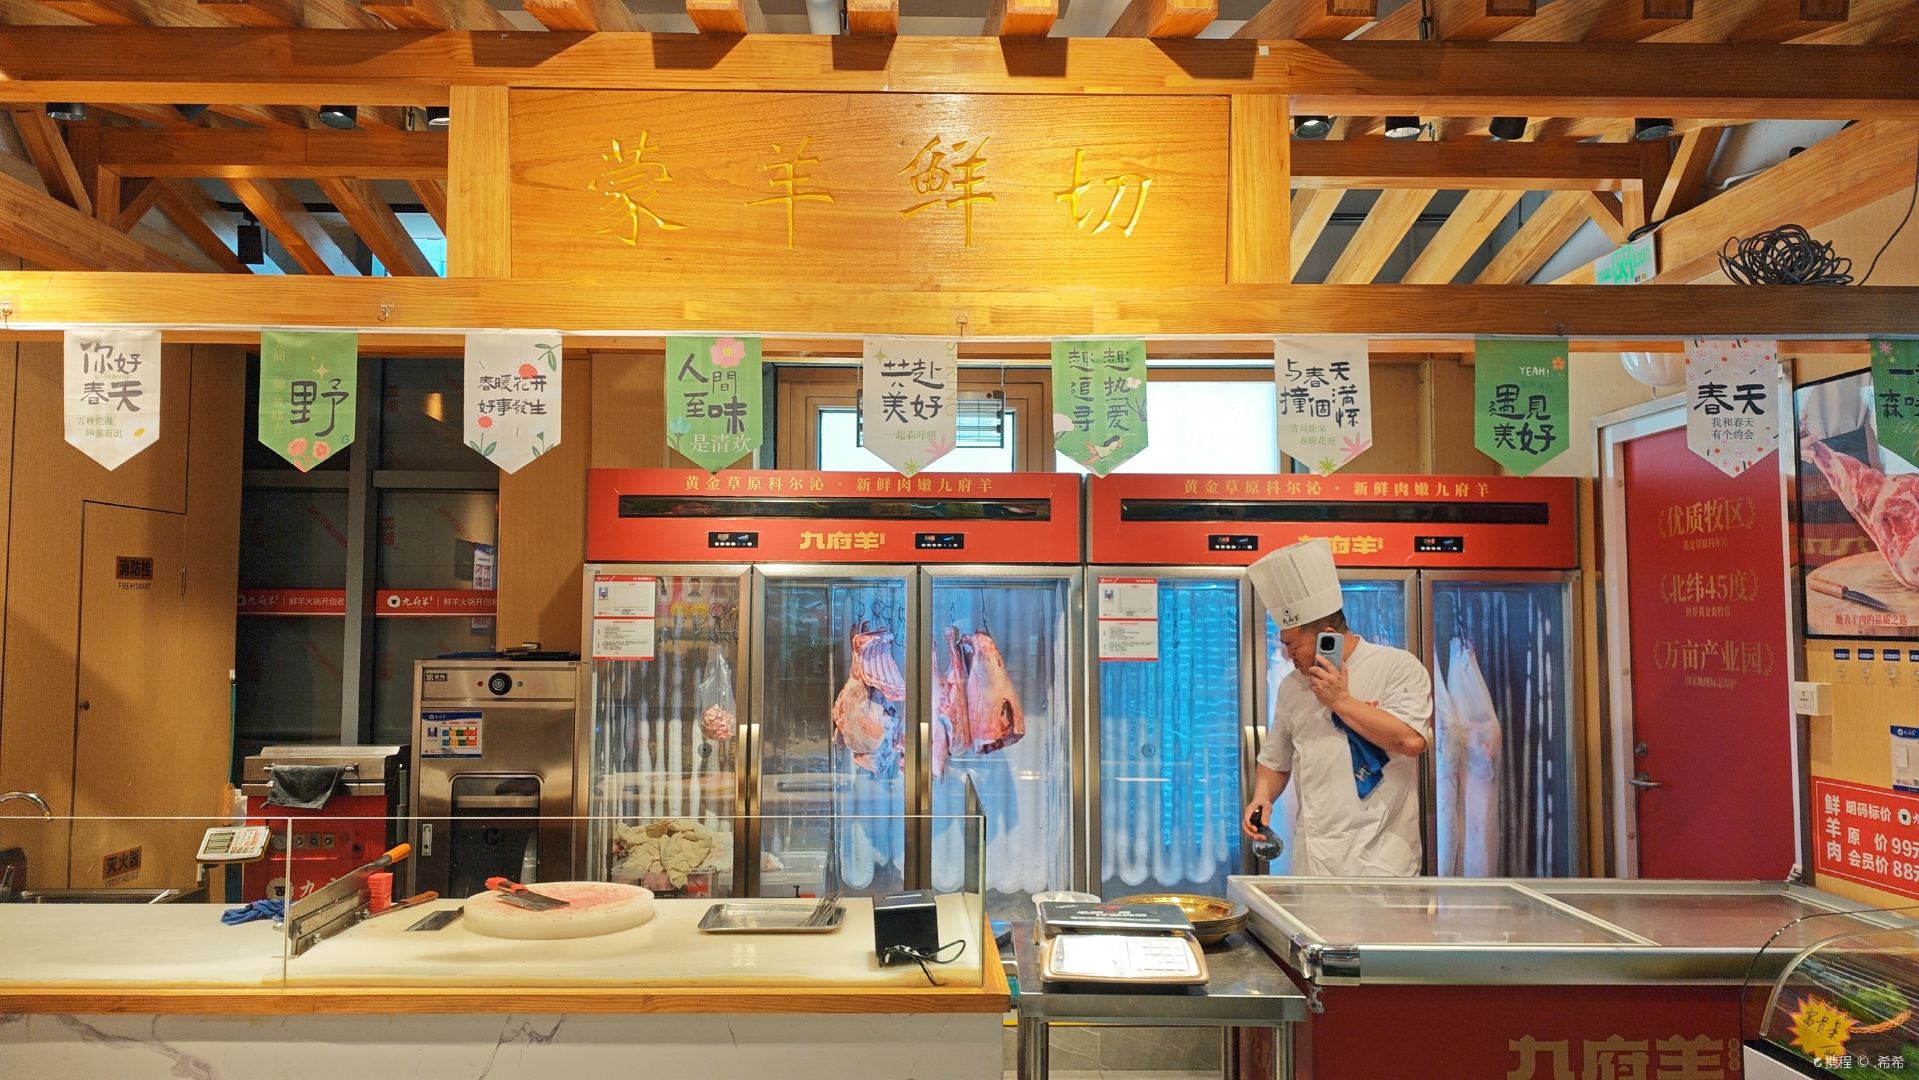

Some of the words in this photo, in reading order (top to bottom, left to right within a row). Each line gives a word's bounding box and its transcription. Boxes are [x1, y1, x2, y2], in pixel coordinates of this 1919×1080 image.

[588, 130, 1152, 249] 蒙羊鲜切
[80, 341, 142, 374] 你好
[1520, 366, 1550, 377] YEAH!
[477, 374, 547, 392] 春暖花开
[881, 358, 944, 389] 共赴
[1285, 358, 1350, 388] 与春天
[80, 381, 143, 412] 春天
[290, 378, 349, 437] 野
[882, 391, 943, 423] 美好
[1693, 382, 1767, 415] 春天
[684, 391, 747, 435] 至味
[1711, 417, 1754, 428] 我和春天
[690, 434, 751, 453] 是清欢
[1493, 422, 1556, 455] 美好
[1711, 428, 1754, 441] 有个约会
[685, 474, 824, 492] 黄金草原科尔沁
[856, 476, 993, 493] 新鲜肉嫩九府羊
[1184, 479, 1322, 496] 黄金草原科尔沁
[1354, 480, 1489, 497] 新鲜肉嫩九府羊
[1668, 498, 1747, 536] 优质牧区
[800, 531, 880, 550] 九府羊
[1299, 535, 1379, 555] 府羊
[119, 558, 151, 577] 消防栓
[1669, 569, 1748, 603] 北纬45度
[1664, 638, 1762, 674] 万亩产业园
[1846, 800, 1891, 823] 明码标价
[1824, 793, 1842, 862] 鲜羊肉
[106, 849, 140, 875] 灭火器
[1848, 849, 1889, 875] 会员价
[1507, 1033, 1724, 1080] 九府羊
